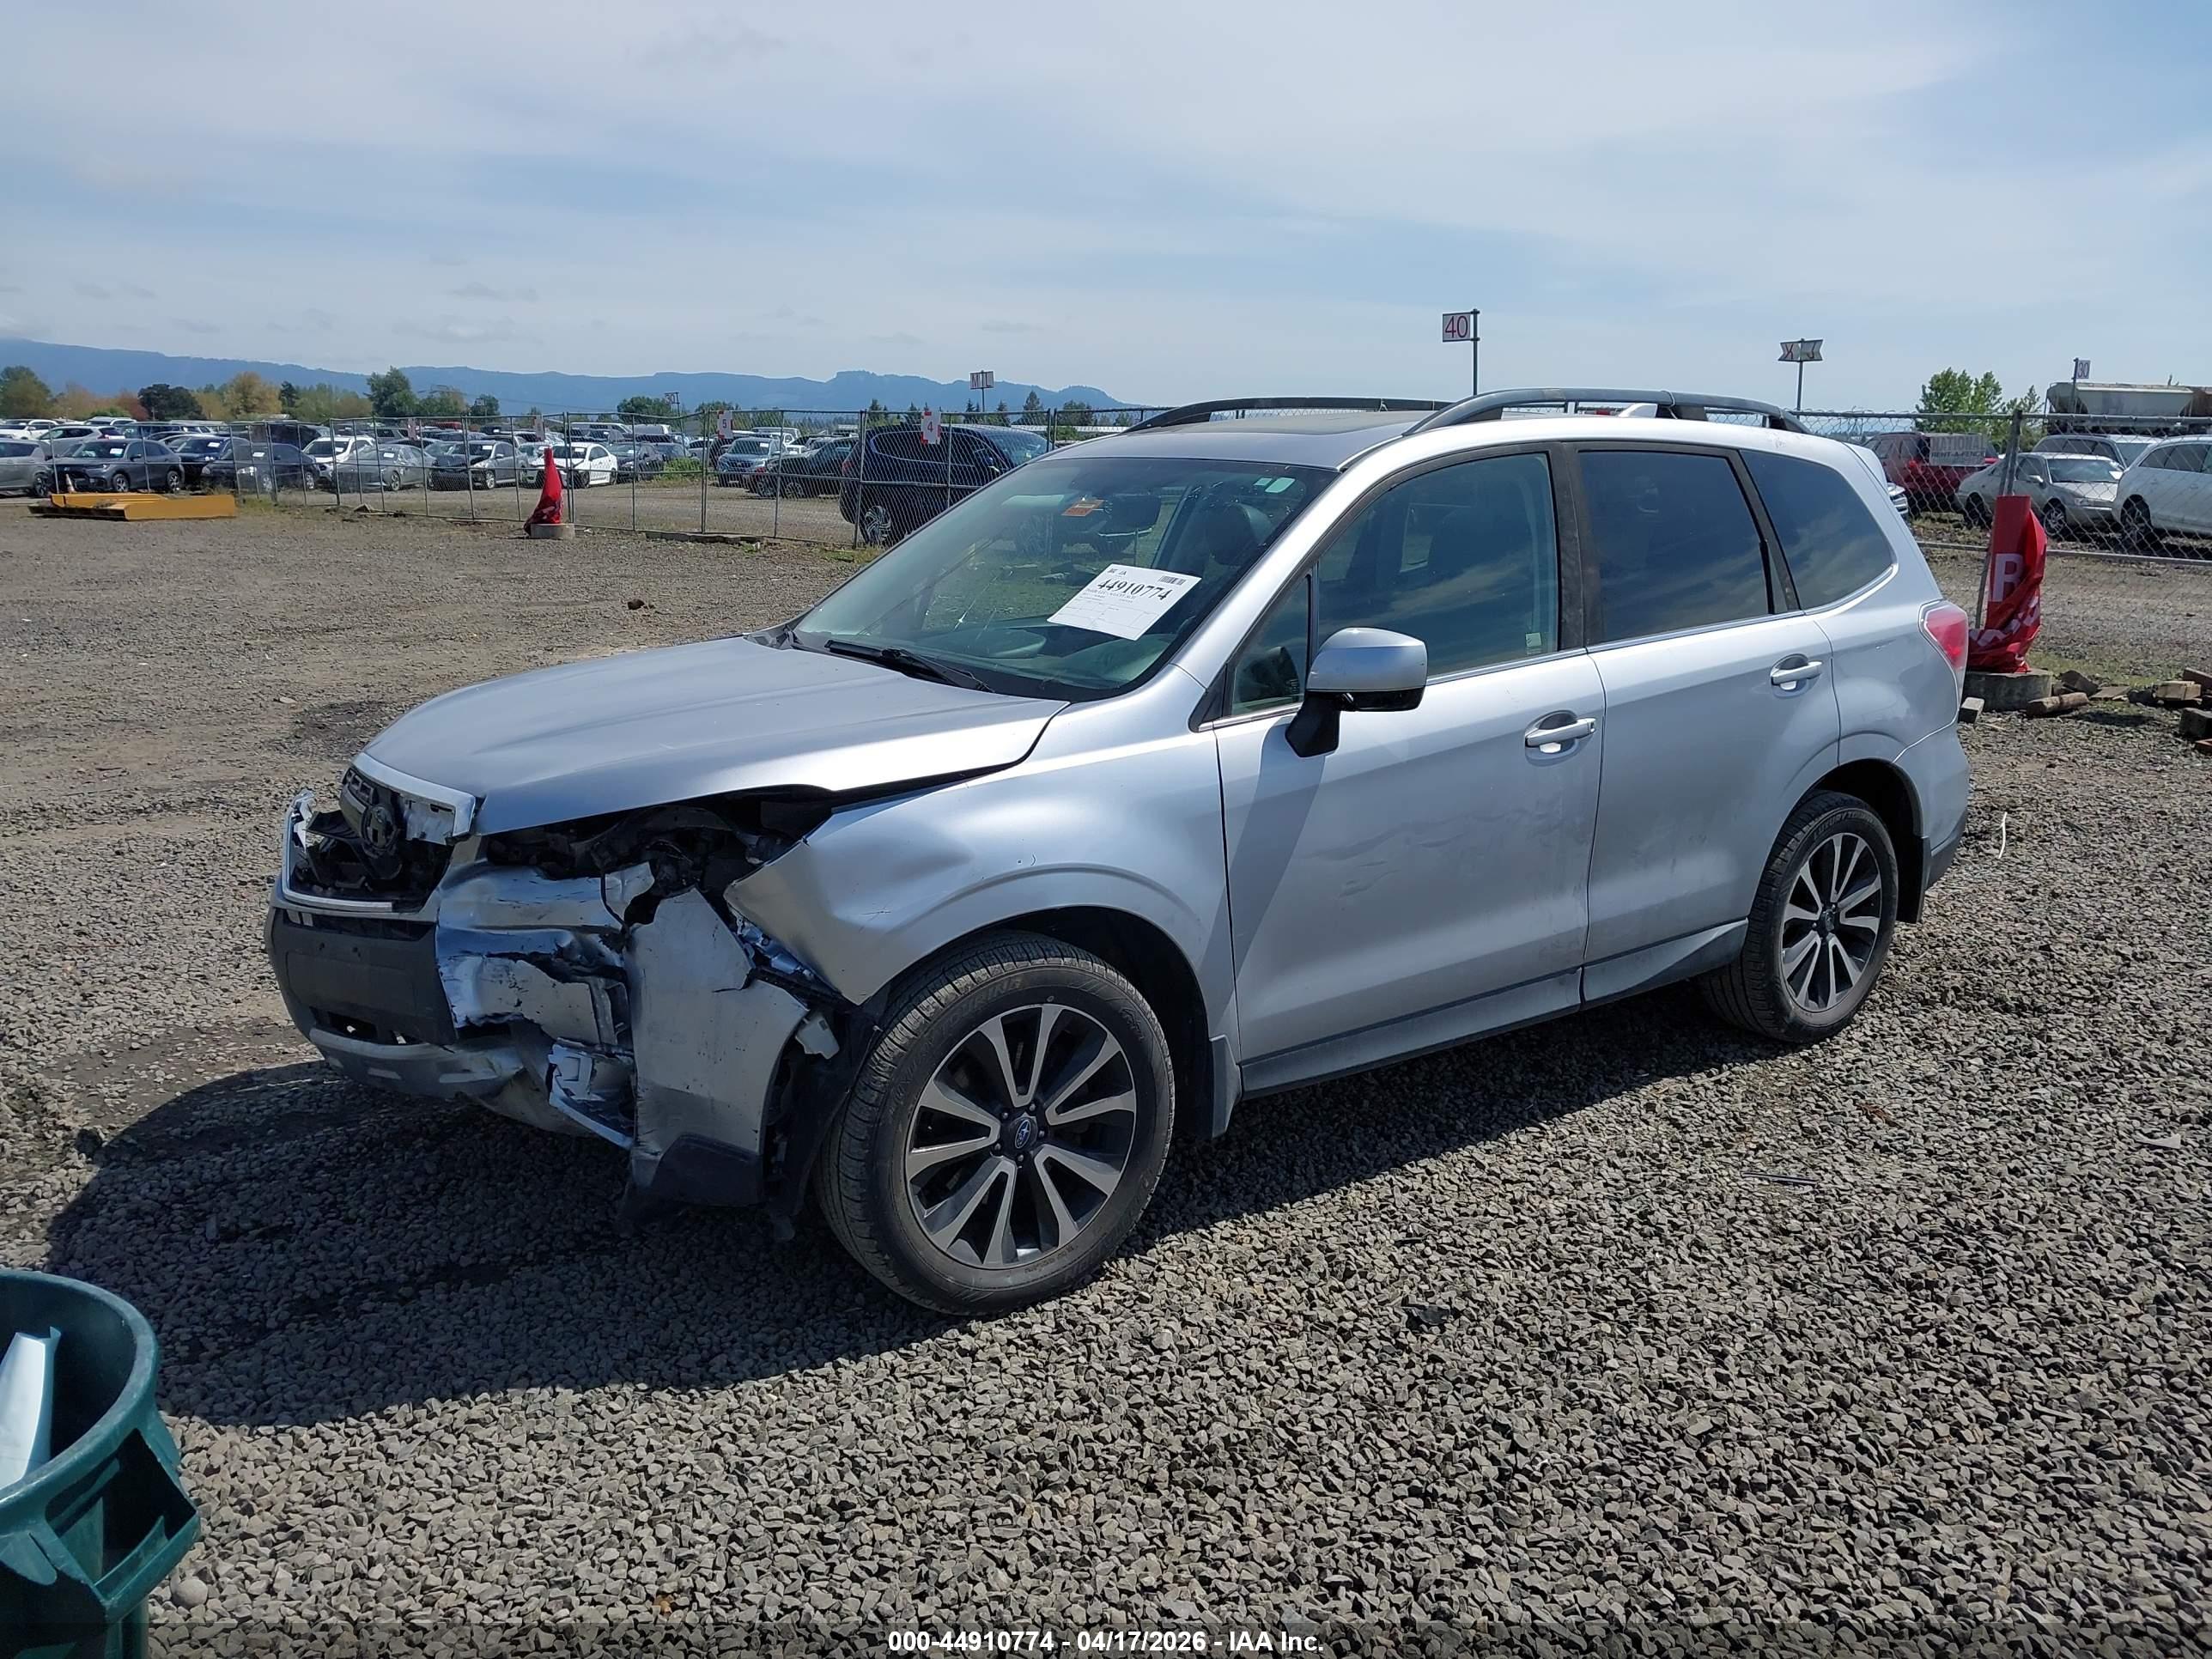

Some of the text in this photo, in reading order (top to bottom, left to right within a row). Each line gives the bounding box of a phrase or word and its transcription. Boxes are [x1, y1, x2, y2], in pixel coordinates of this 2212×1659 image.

[1444, 315, 1468, 339] 40
[2078, 362, 2089, 378] 30
[722, 418, 727, 428] 5
[927, 421, 933, 433] 4
[1931, 436, 1985, 451] NATIONAL
[1097, 578, 1174, 600] 44910774
